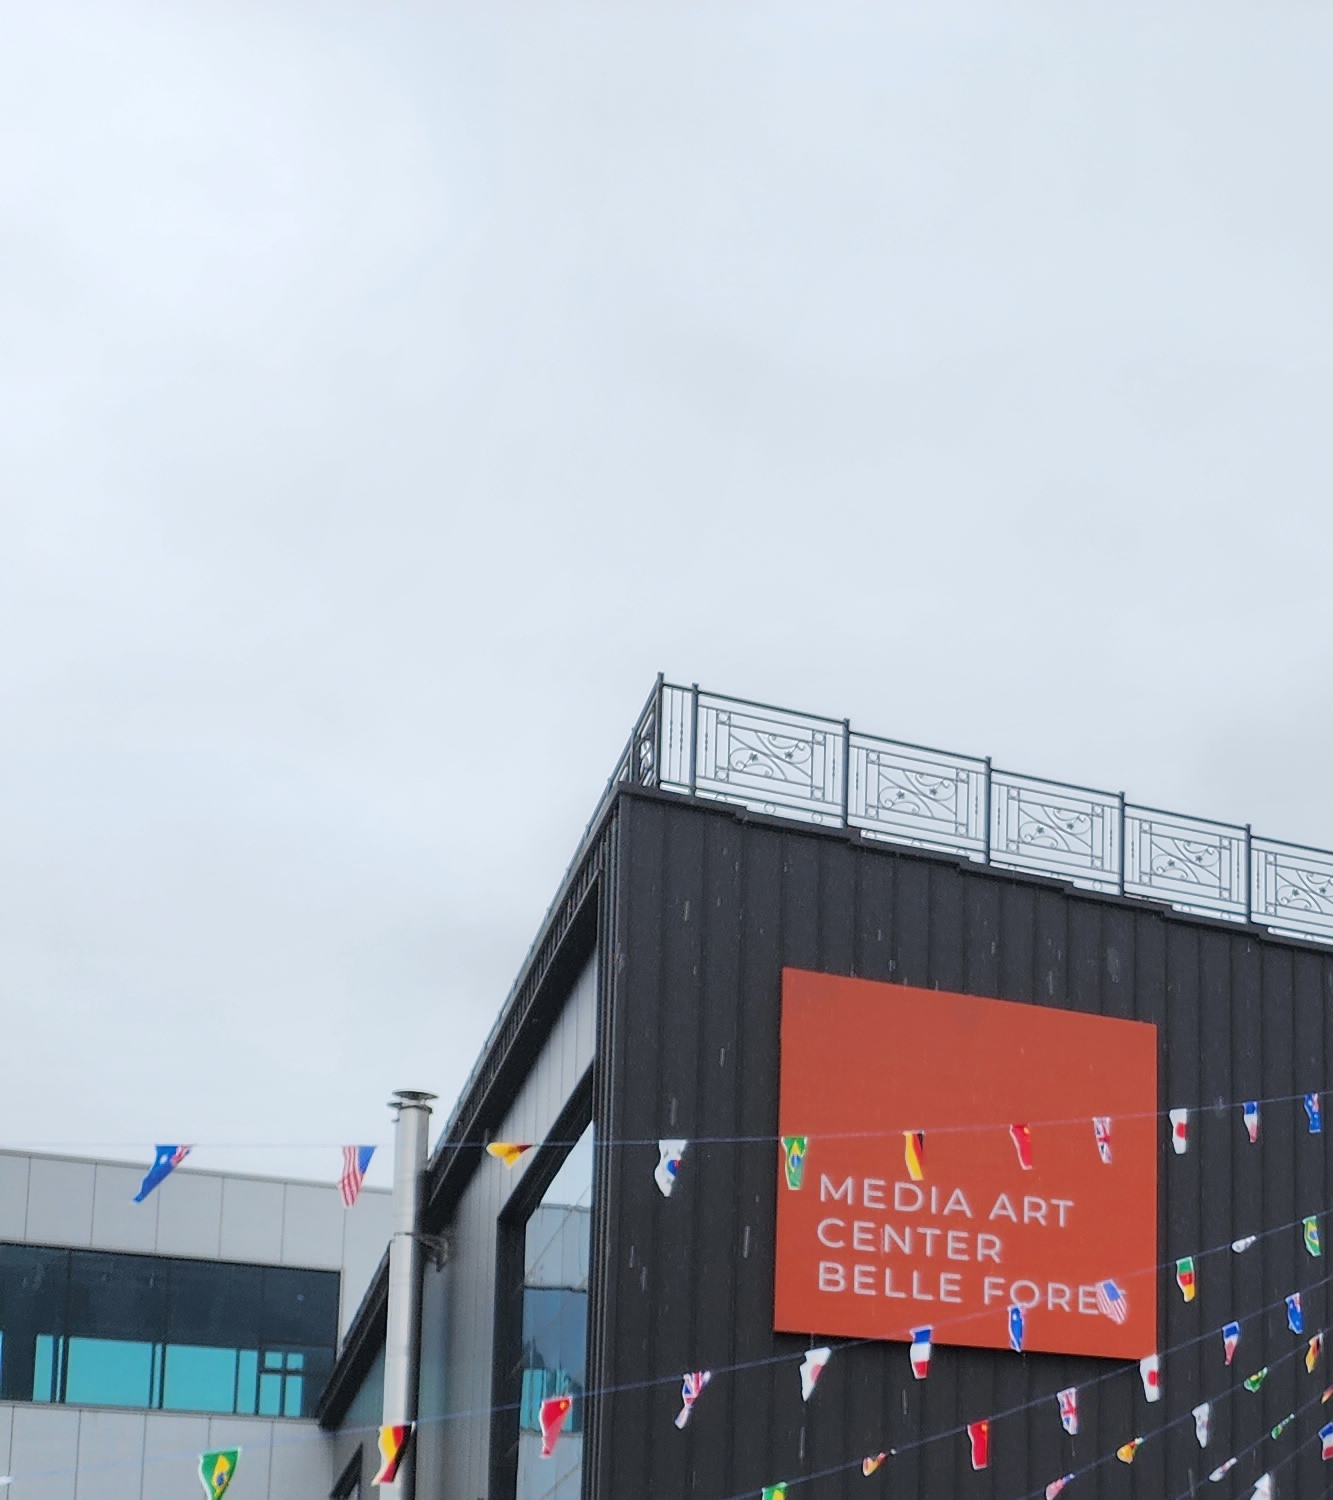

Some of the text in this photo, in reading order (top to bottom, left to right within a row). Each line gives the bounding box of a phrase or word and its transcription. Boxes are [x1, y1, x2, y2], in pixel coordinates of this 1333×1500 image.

[820, 1174, 1075, 1228] MEDIA ART
[817, 1218, 1001, 1264] CENTER
[818, 1261, 1127, 1315] BELLE FORE
